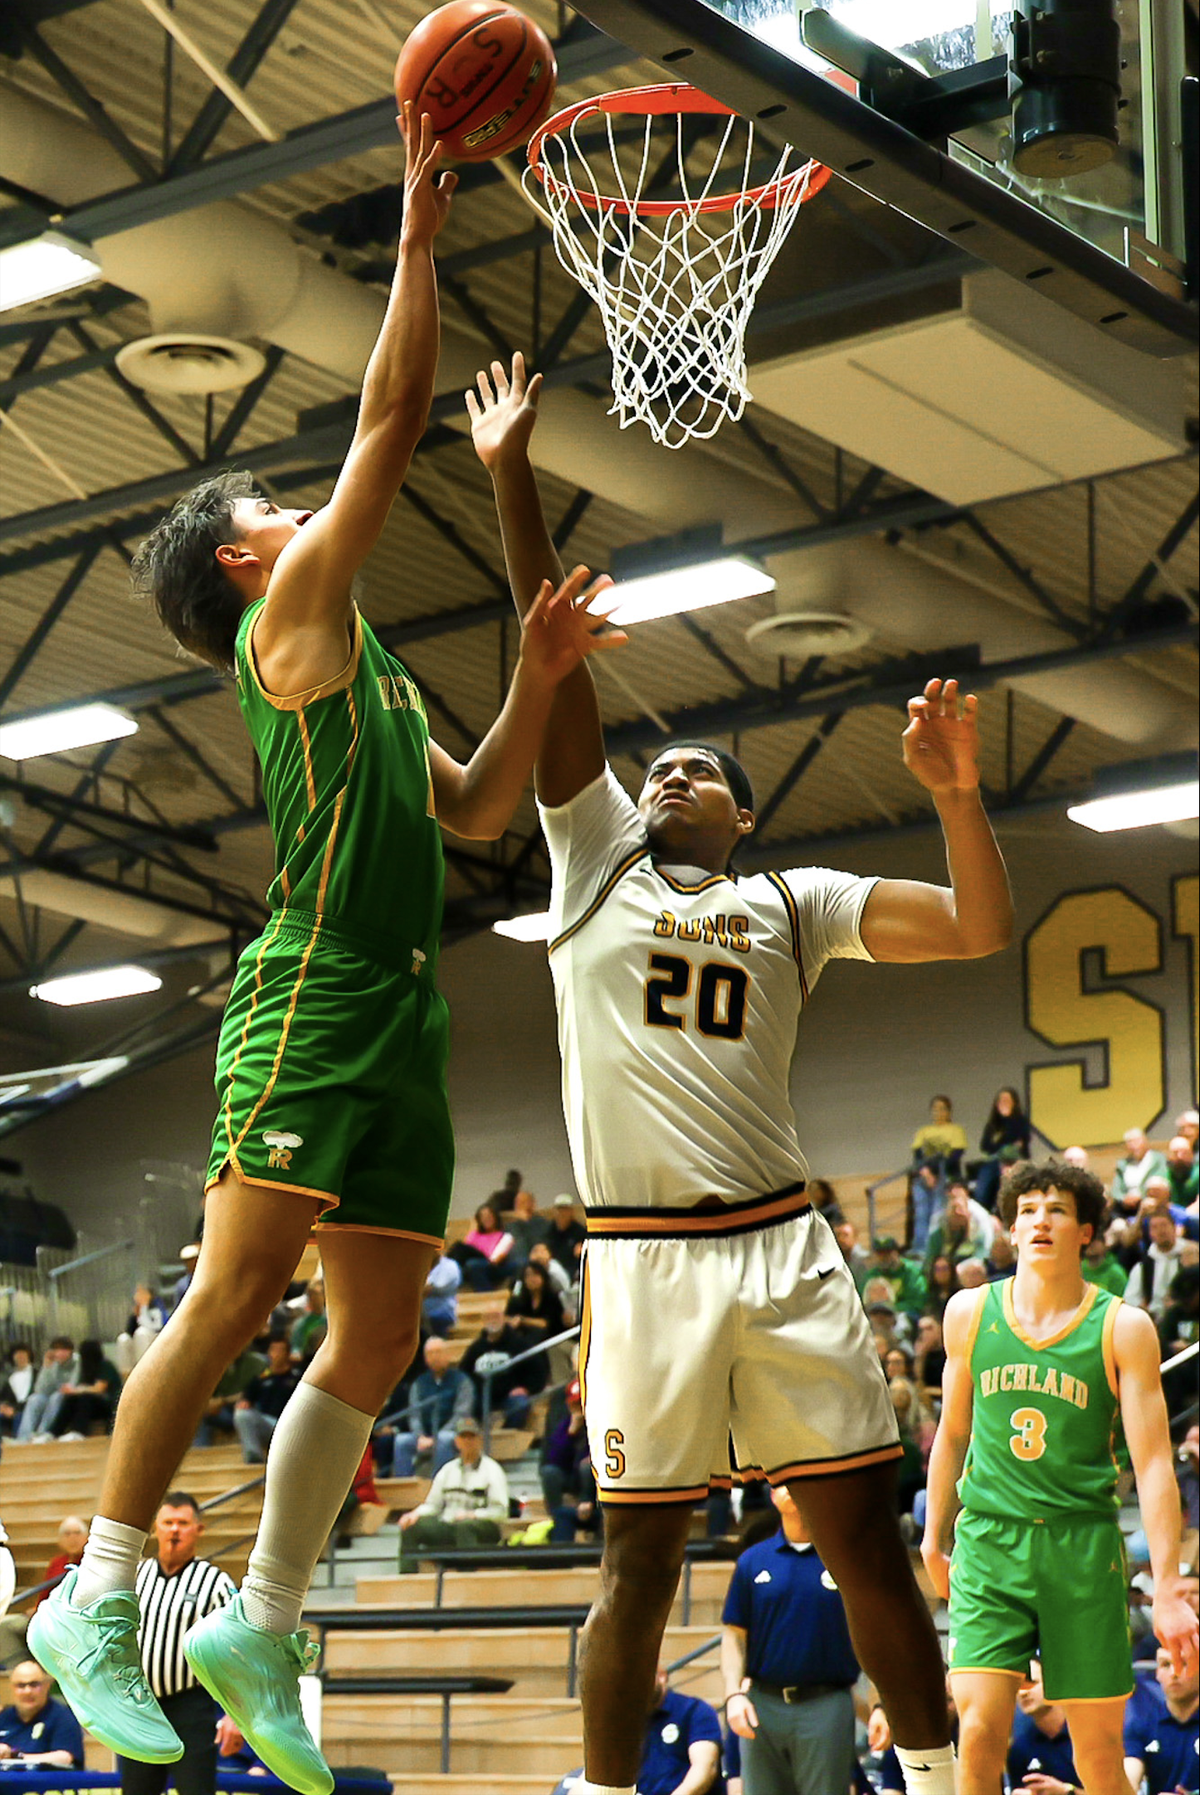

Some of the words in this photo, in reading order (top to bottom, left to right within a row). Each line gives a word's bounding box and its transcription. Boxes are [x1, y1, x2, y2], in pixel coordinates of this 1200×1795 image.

[643, 950, 752, 1043] 20
[1022, 874, 1199, 1151] S
[980, 1363, 1089, 1410] RICHLAND
[604, 1428, 626, 1479] S
[1009, 1407, 1048, 1461] 3
